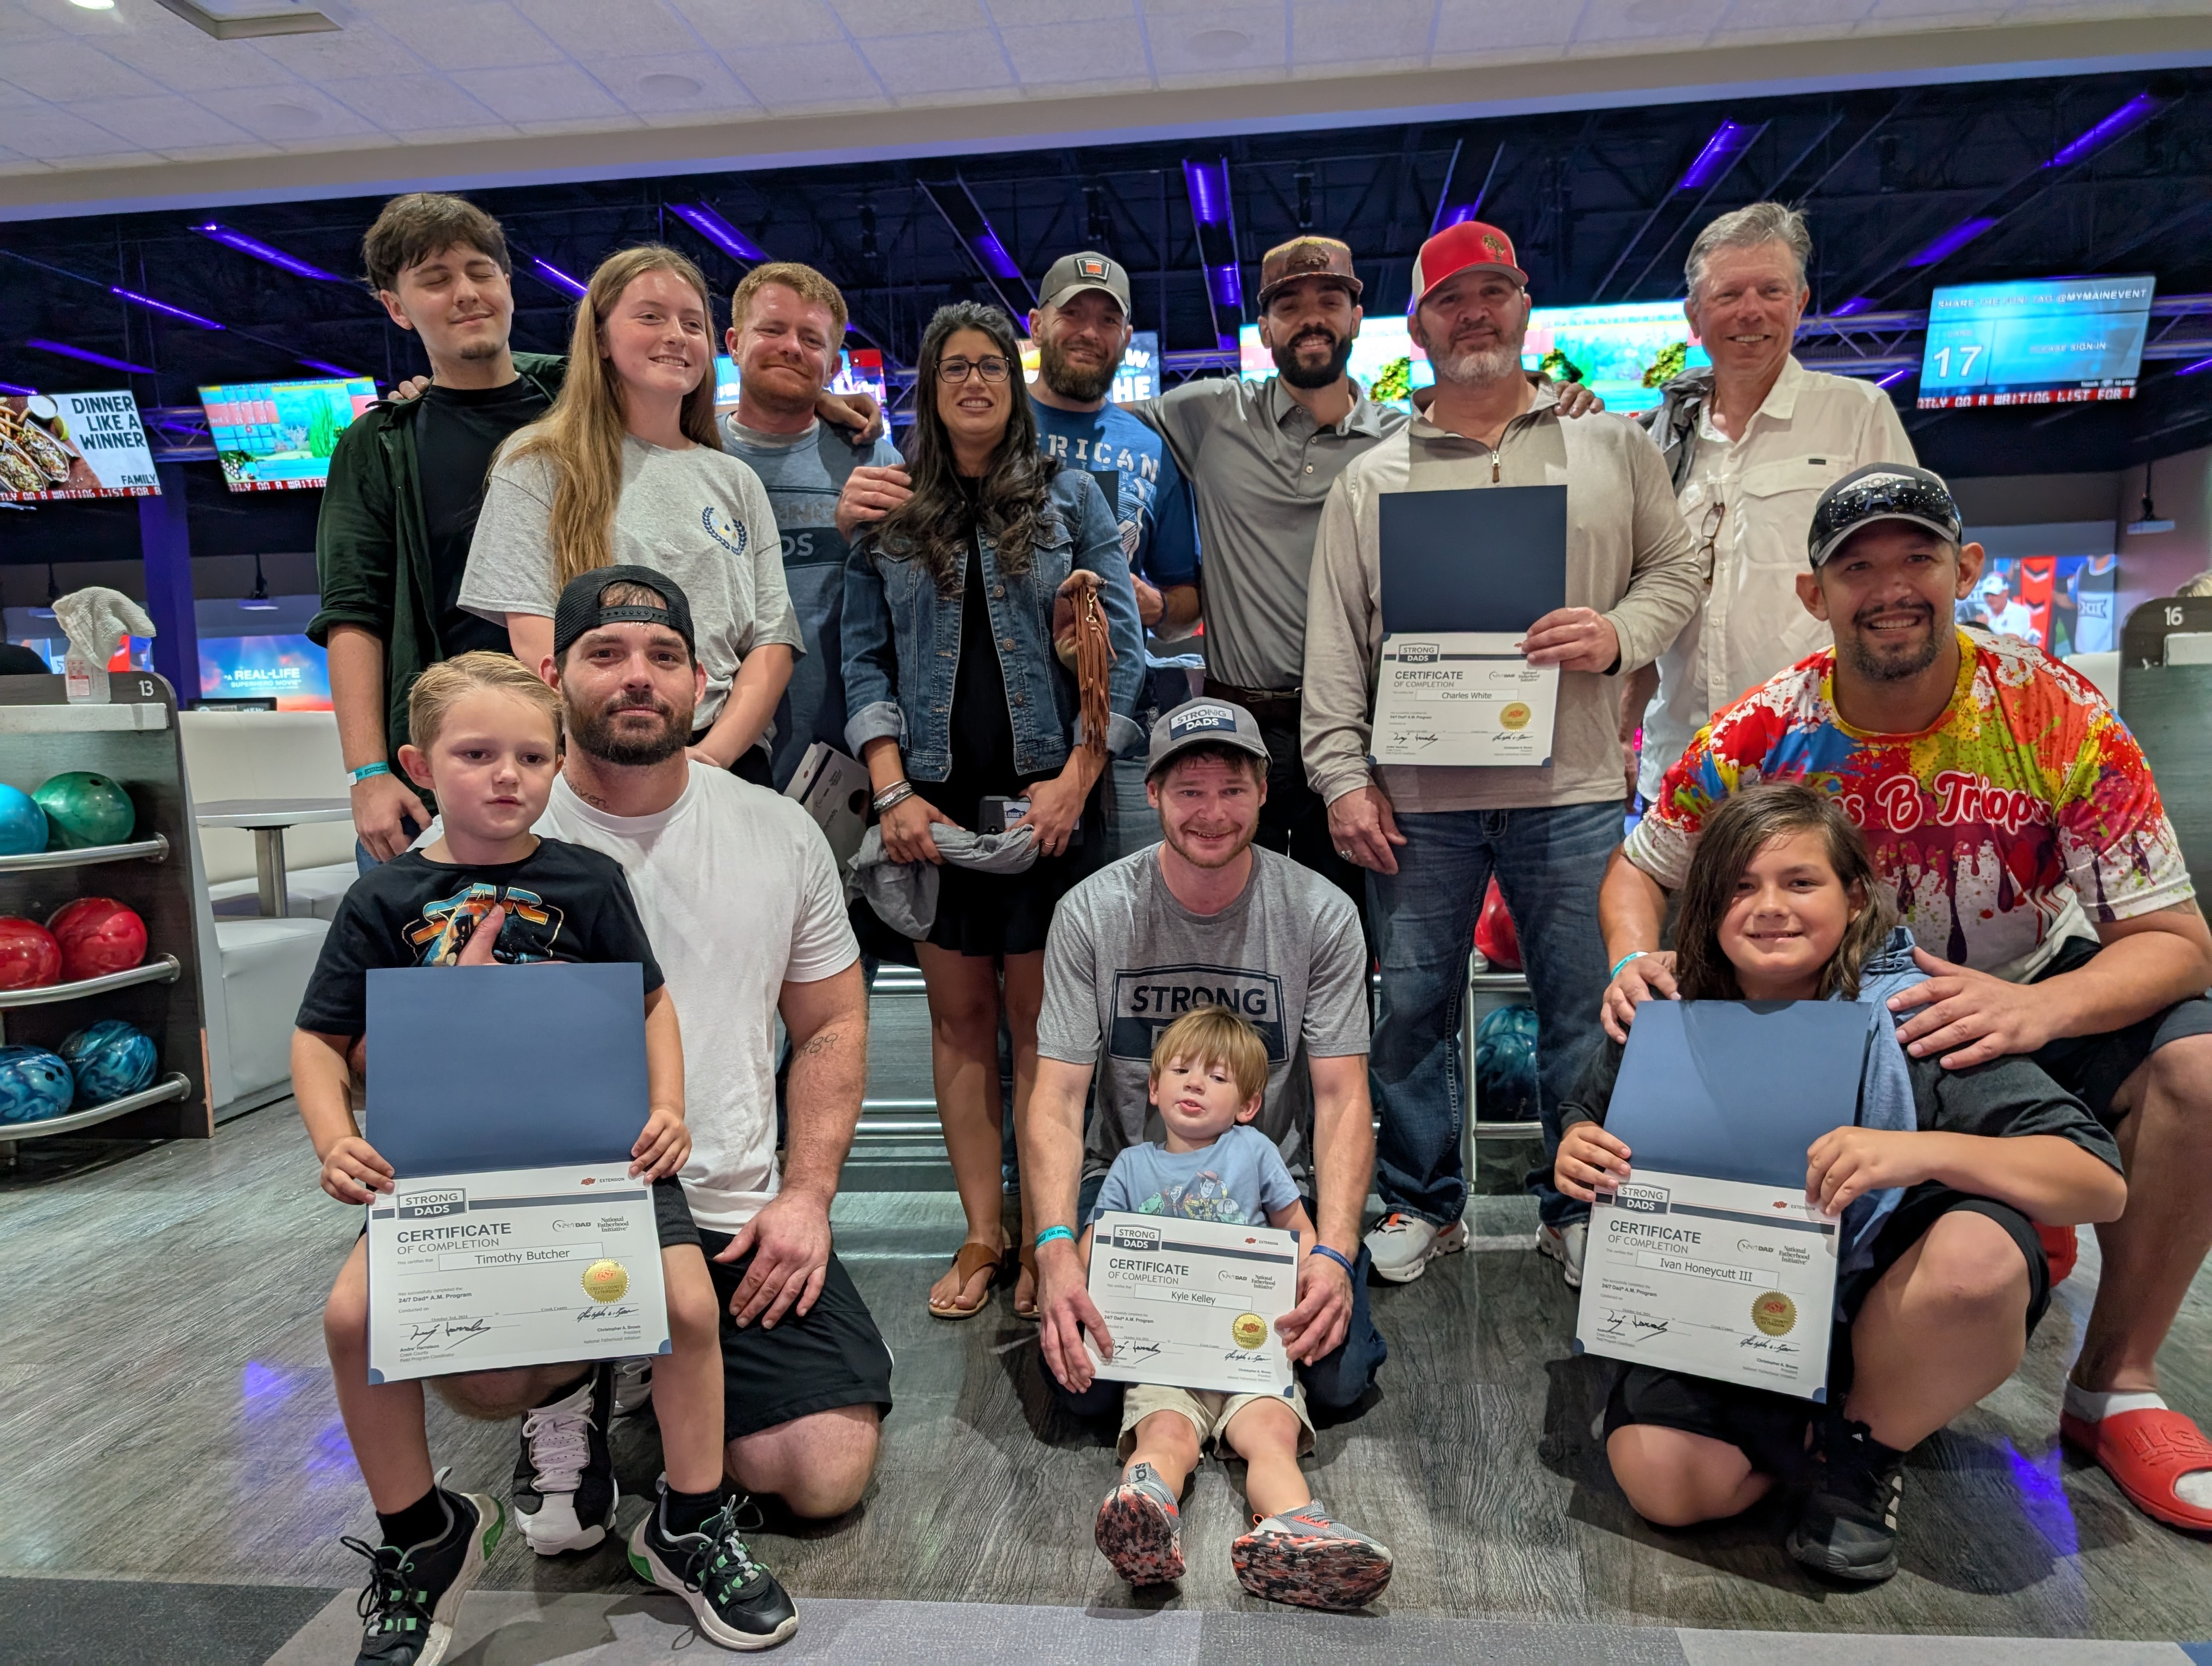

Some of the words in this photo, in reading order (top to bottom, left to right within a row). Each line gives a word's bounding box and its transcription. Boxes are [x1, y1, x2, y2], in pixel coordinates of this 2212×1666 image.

[1938, 299, 1975, 309] SHARE
[1979, 298, 2000, 307] THE
[2056, 289, 2147, 304] @MYMAINEVENT
[1933, 345, 1983, 379] 17
[1994, 390, 2050, 404] WAITING
[2057, 388, 2091, 402] LIST
[2098, 387, 2122, 400] FOR
[71, 396, 136, 414] DINNER
[86, 414, 124, 432] LIKE
[129, 414, 140, 430] A
[79, 433, 146, 450] WINNER
[121, 474, 156, 485] FAMILY
[287, 478, 327, 490] WAITIN
[52, 489, 95, 499] WAITING
[100, 488, 124, 497] LIST
[130, 486, 149, 496] FOR
[2164, 606, 2184, 626] 16
[235, 668, 300, 680] REAL-LIFE
[1395, 671, 1463, 680] CERTIFICATE
[138, 680, 154, 696] 13
[231, 680, 273, 688] SUPERHERO
[1177, 709, 1226, 725] STRONG
[1186, 718, 1219, 731] DADS
[1875, 774, 1923, 834] B
[1130, 985, 1267, 1015] STRONG
[406, 1193, 458, 1206] STRONG
[1622, 1187, 1663, 1200] STRONG
[414, 1204, 450, 1216] DADS
[1627, 1199, 1655, 1210] DADS
[397, 1223, 512, 1243] CERTIFICATE
[1119, 1229, 1155, 1239] STRONG
[1610, 1220, 1701, 1244] CERTIFICATE
[397, 1245, 415, 1255] OF
[419, 1238, 499, 1253] COMPLETION
[1124, 1239, 1148, 1248] DADS
[1608, 1234, 1622, 1243] OF
[1624, 1237, 1688, 1254] COMPLETION
[1784, 1246, 1806, 1254] National
[474, 1253, 522, 1265] Timothy
[527, 1249, 570, 1261] Butcher
[1778, 1251, 1810, 1260] Fatherhood
[1109, 1258, 1189, 1276] CERTIFICATE
[1660, 1258, 1681, 1270] Ivan
[1685, 1262, 1736, 1280] Honeycutt
[1739, 1271, 1752, 1282] III
[1122, 1272, 1179, 1285] COMPLETION
[1171, 1291, 1188, 1302] Kyle
[1191, 1293, 1216, 1305] Kelley
